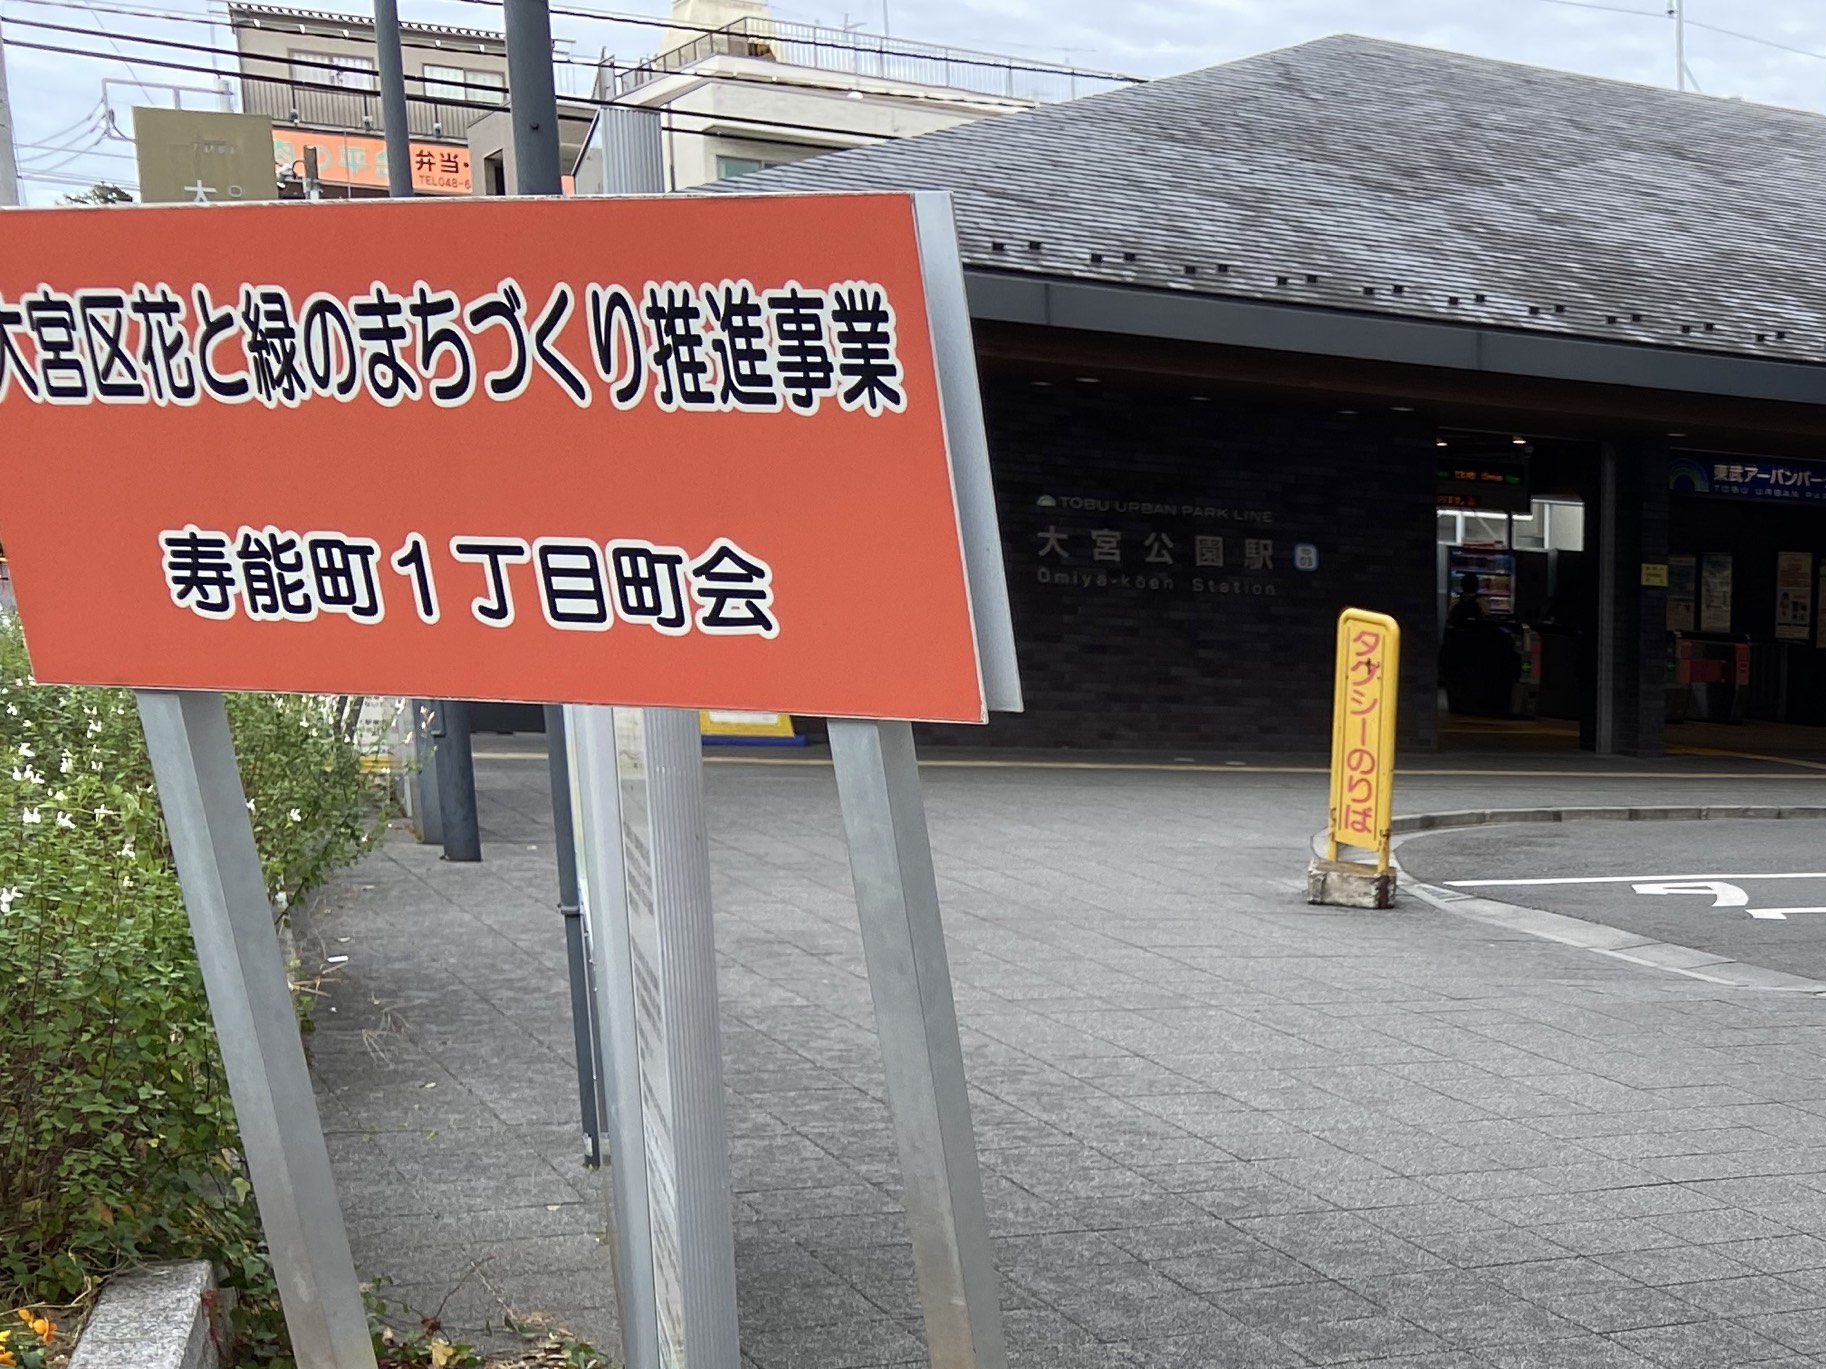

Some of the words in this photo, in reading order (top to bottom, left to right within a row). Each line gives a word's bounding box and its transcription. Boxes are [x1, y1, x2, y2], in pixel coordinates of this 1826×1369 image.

[0, 284, 903, 411] 大宮区花と緑のまちづくり推進事業
[1059, 496, 1110, 511] TOBU
[1115, 502, 1177, 516] URBAN
[1181, 505, 1229, 519] PARK
[1233, 510, 1273, 523] LINE
[1037, 525, 1275, 570] 大宮公園駅
[1192, 577, 1277, 597] Station
[1344, 630, 1381, 834] タクシーのりば
